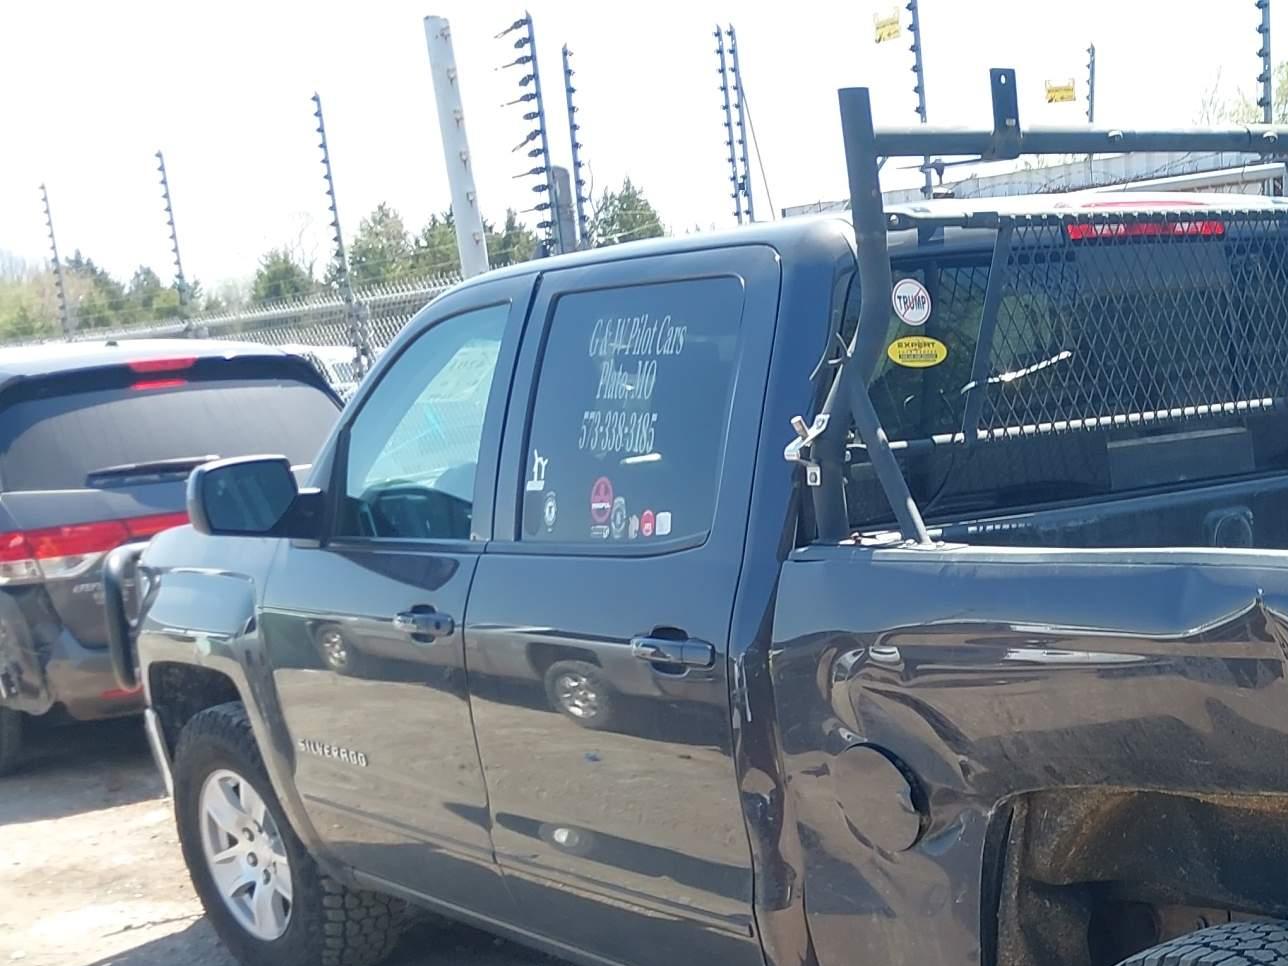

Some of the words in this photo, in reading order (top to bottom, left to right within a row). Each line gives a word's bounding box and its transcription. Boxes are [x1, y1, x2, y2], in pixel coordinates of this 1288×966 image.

[896, 295, 927, 311] TRUMP
[630, 313, 658, 355] Pilot
[655, 314, 688, 355] Cars
[298, 738, 369, 768] SILVERADO
